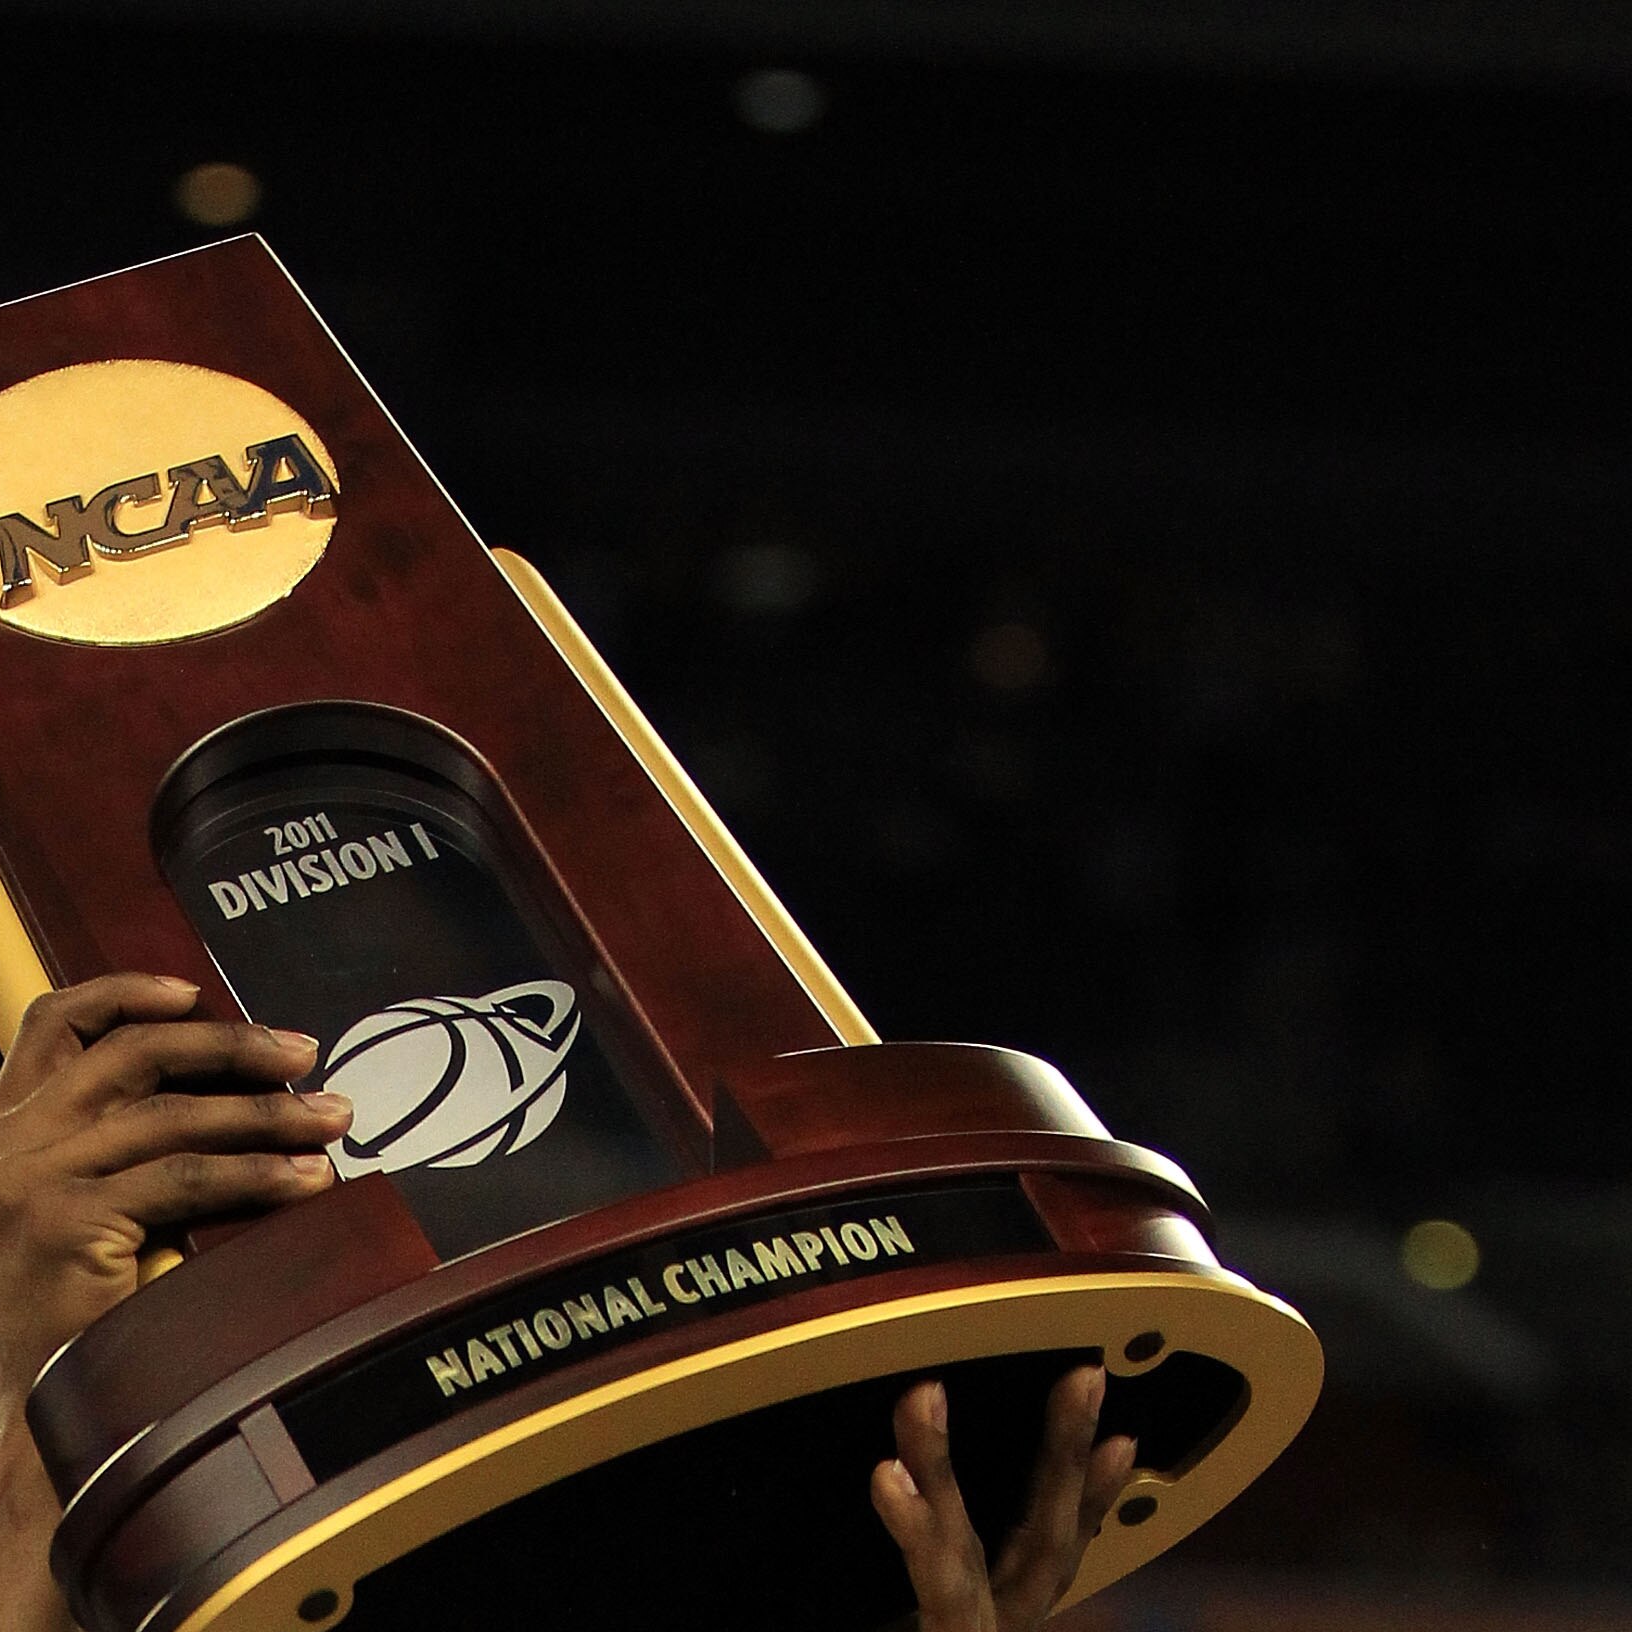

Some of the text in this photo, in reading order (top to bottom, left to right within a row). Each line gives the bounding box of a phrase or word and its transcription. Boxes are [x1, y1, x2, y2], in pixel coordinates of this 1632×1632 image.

[208, 822, 440, 921] DIVISION I
[264, 811, 339, 857] 2011
[425, 1214, 916, 1398] NATIONAL CHAMPION
